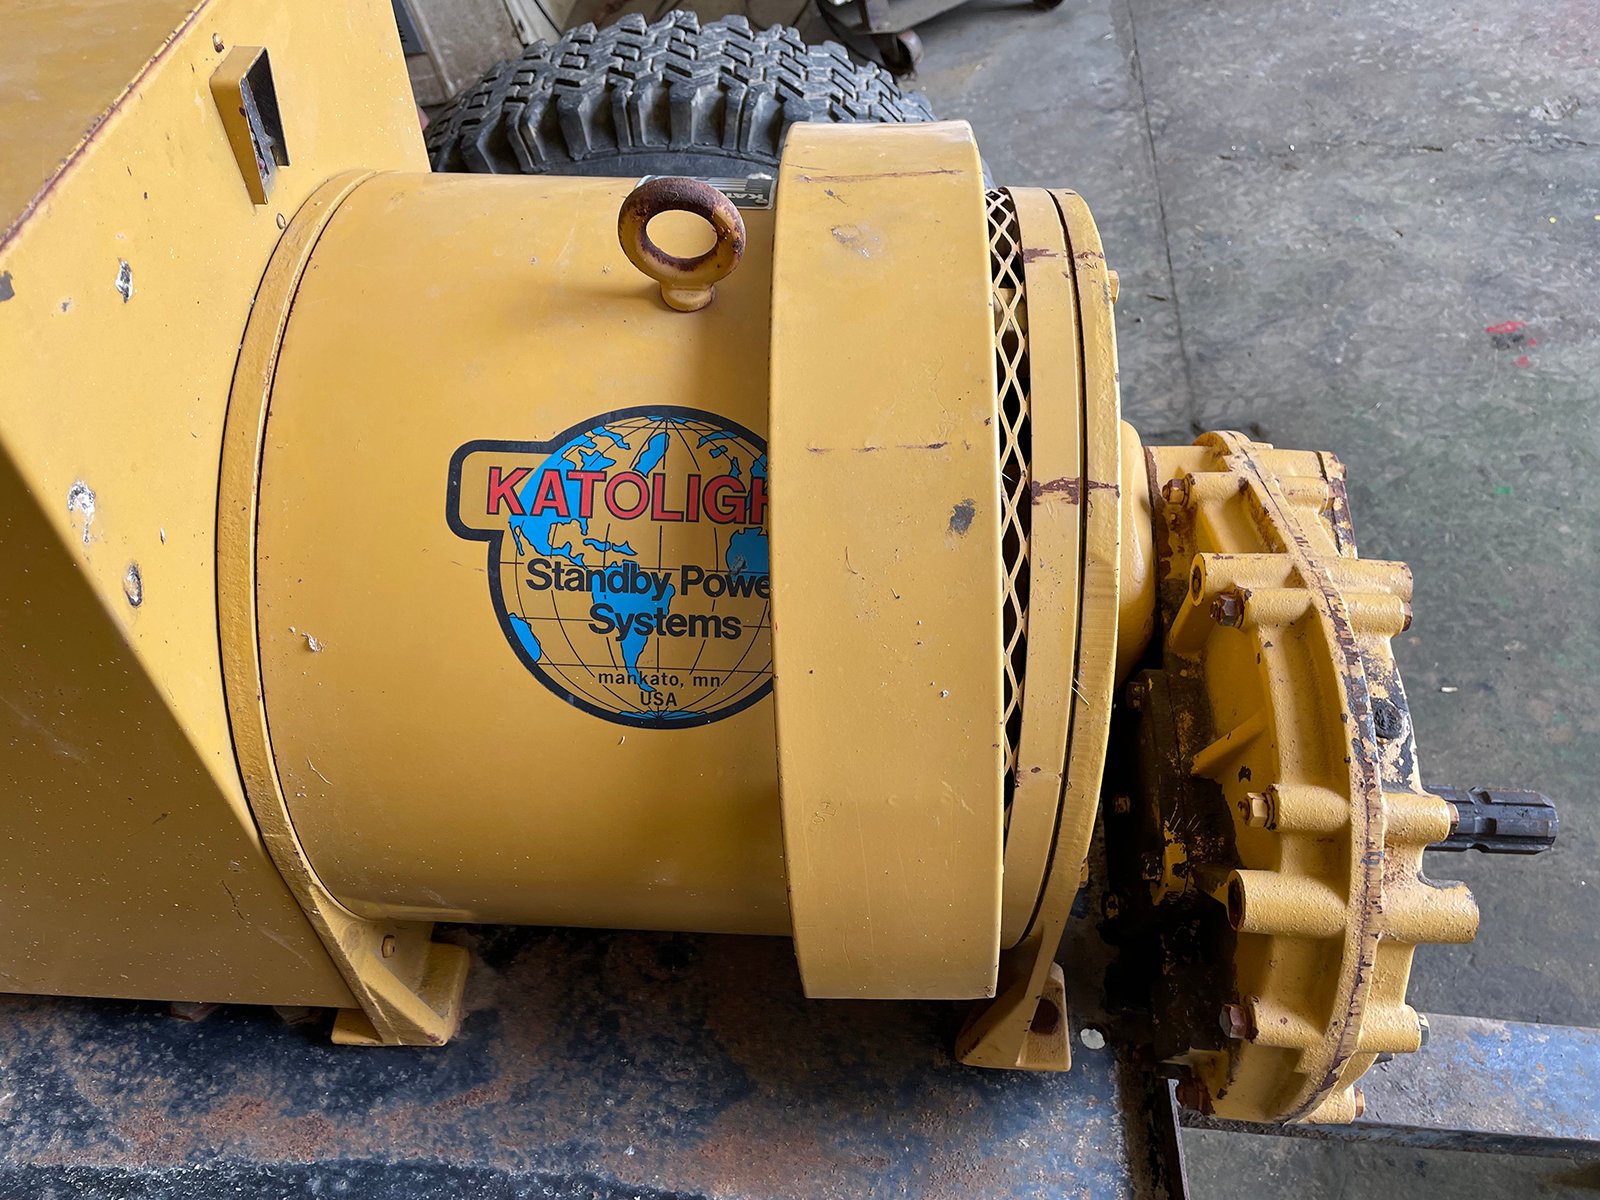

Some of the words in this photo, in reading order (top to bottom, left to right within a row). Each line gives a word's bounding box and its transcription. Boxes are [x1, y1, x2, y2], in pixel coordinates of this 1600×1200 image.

[525, 558, 672, 600] Standby
[680, 564, 769, 599] Powe
[588, 603, 742, 641] Systems
[598, 670, 685, 688] mankato,
[692, 675, 721, 688] mn
[639, 691, 678, 707] USA
